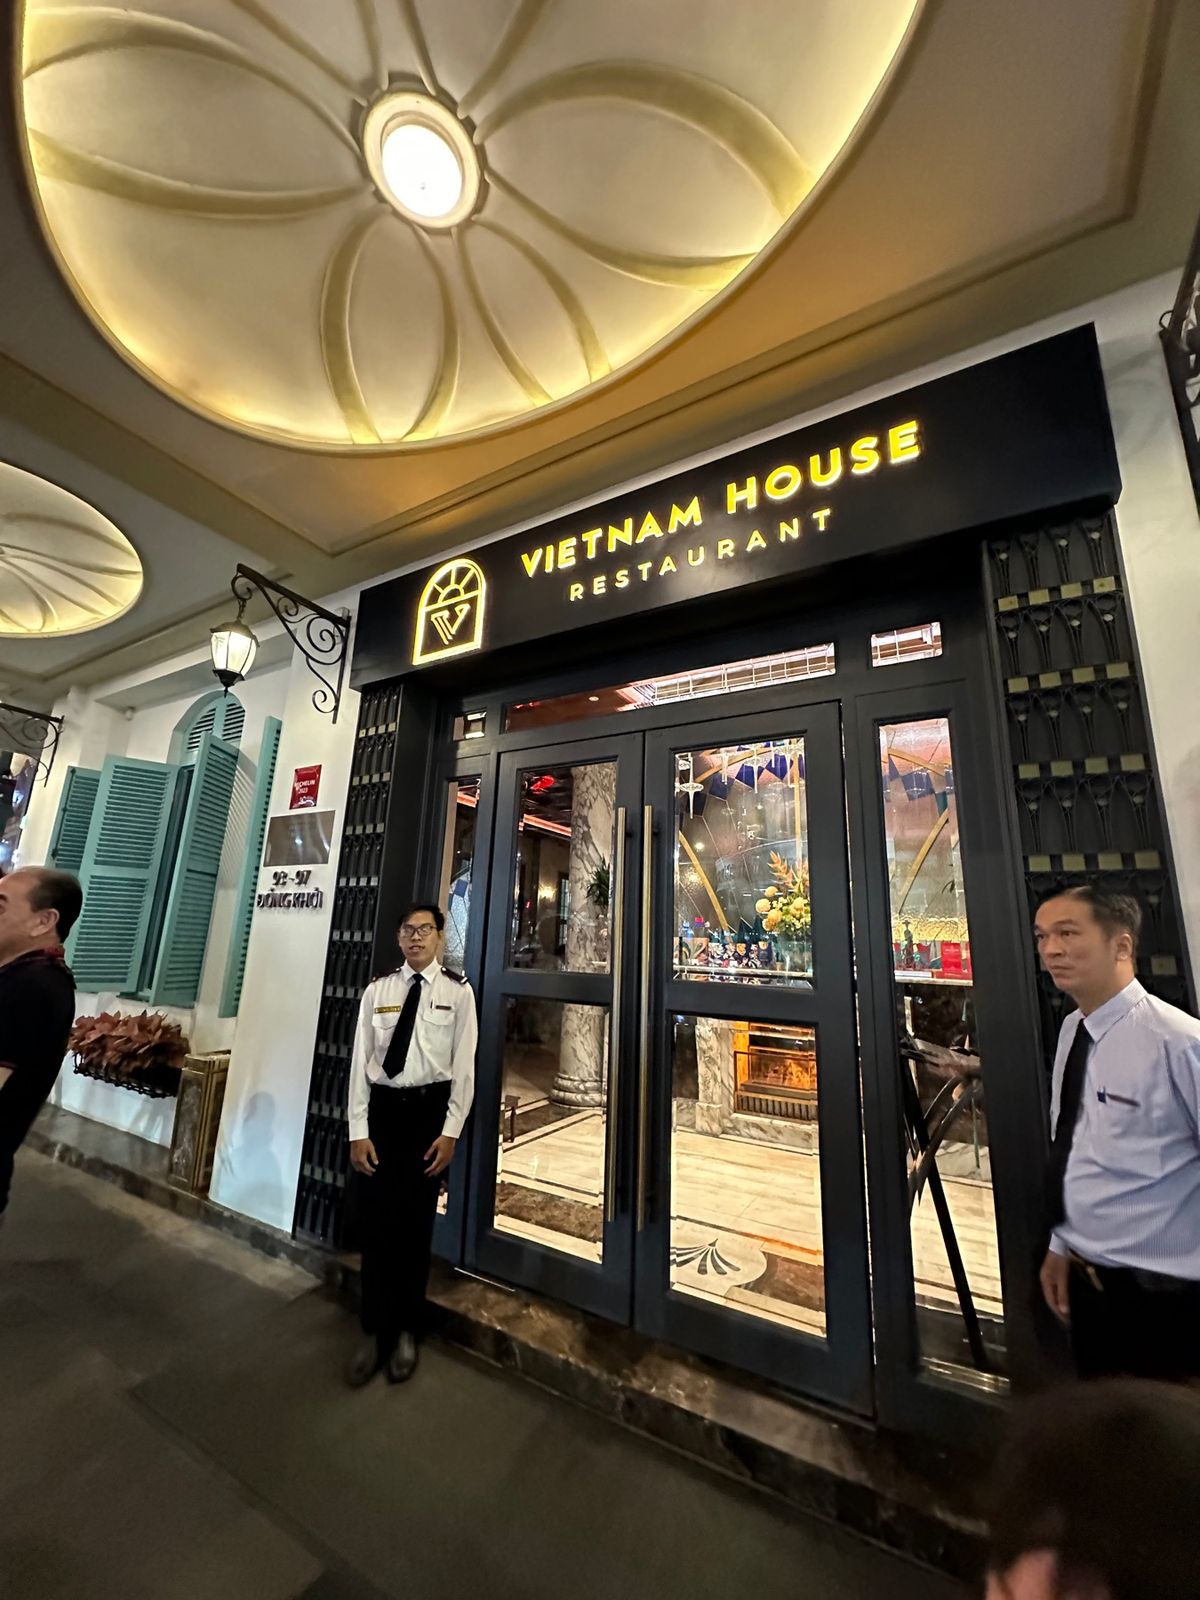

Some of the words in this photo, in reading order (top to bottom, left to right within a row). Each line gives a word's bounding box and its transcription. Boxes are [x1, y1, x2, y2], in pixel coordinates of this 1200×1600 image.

[521, 497, 702, 578] VIETNAM
[727, 420, 921, 514] HOUSE
[569, 509, 833, 602] RESTAURANT
